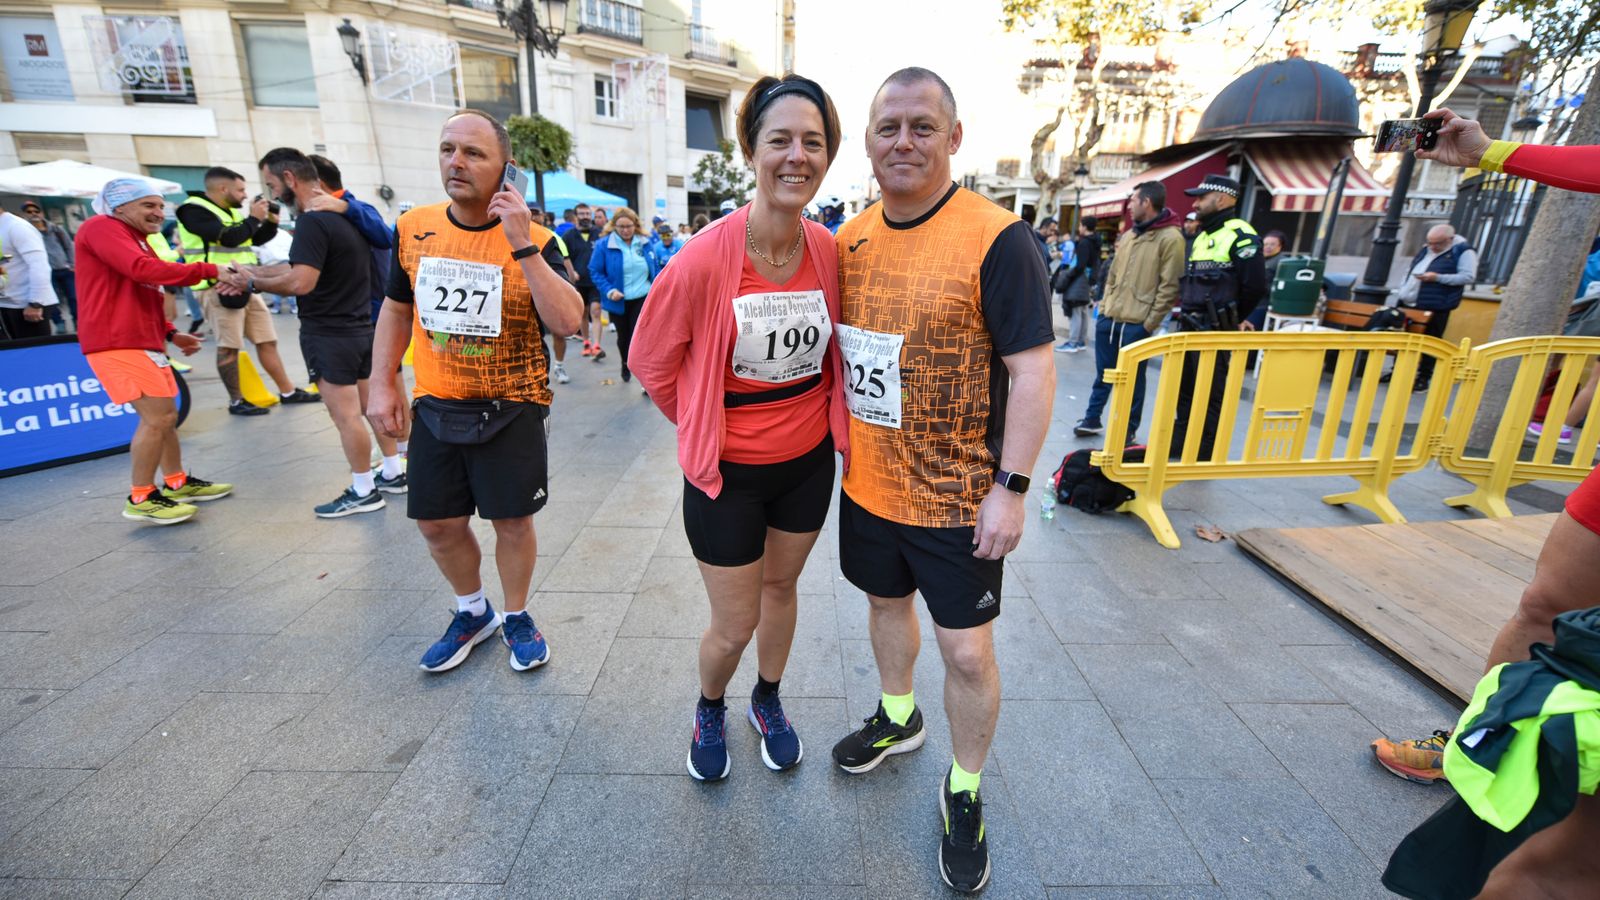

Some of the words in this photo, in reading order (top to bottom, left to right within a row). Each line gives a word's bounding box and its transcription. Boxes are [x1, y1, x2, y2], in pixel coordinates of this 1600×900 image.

[434, 286, 489, 315] 227
[762, 325, 820, 361] 199
[0, 375, 105, 407] tamie
